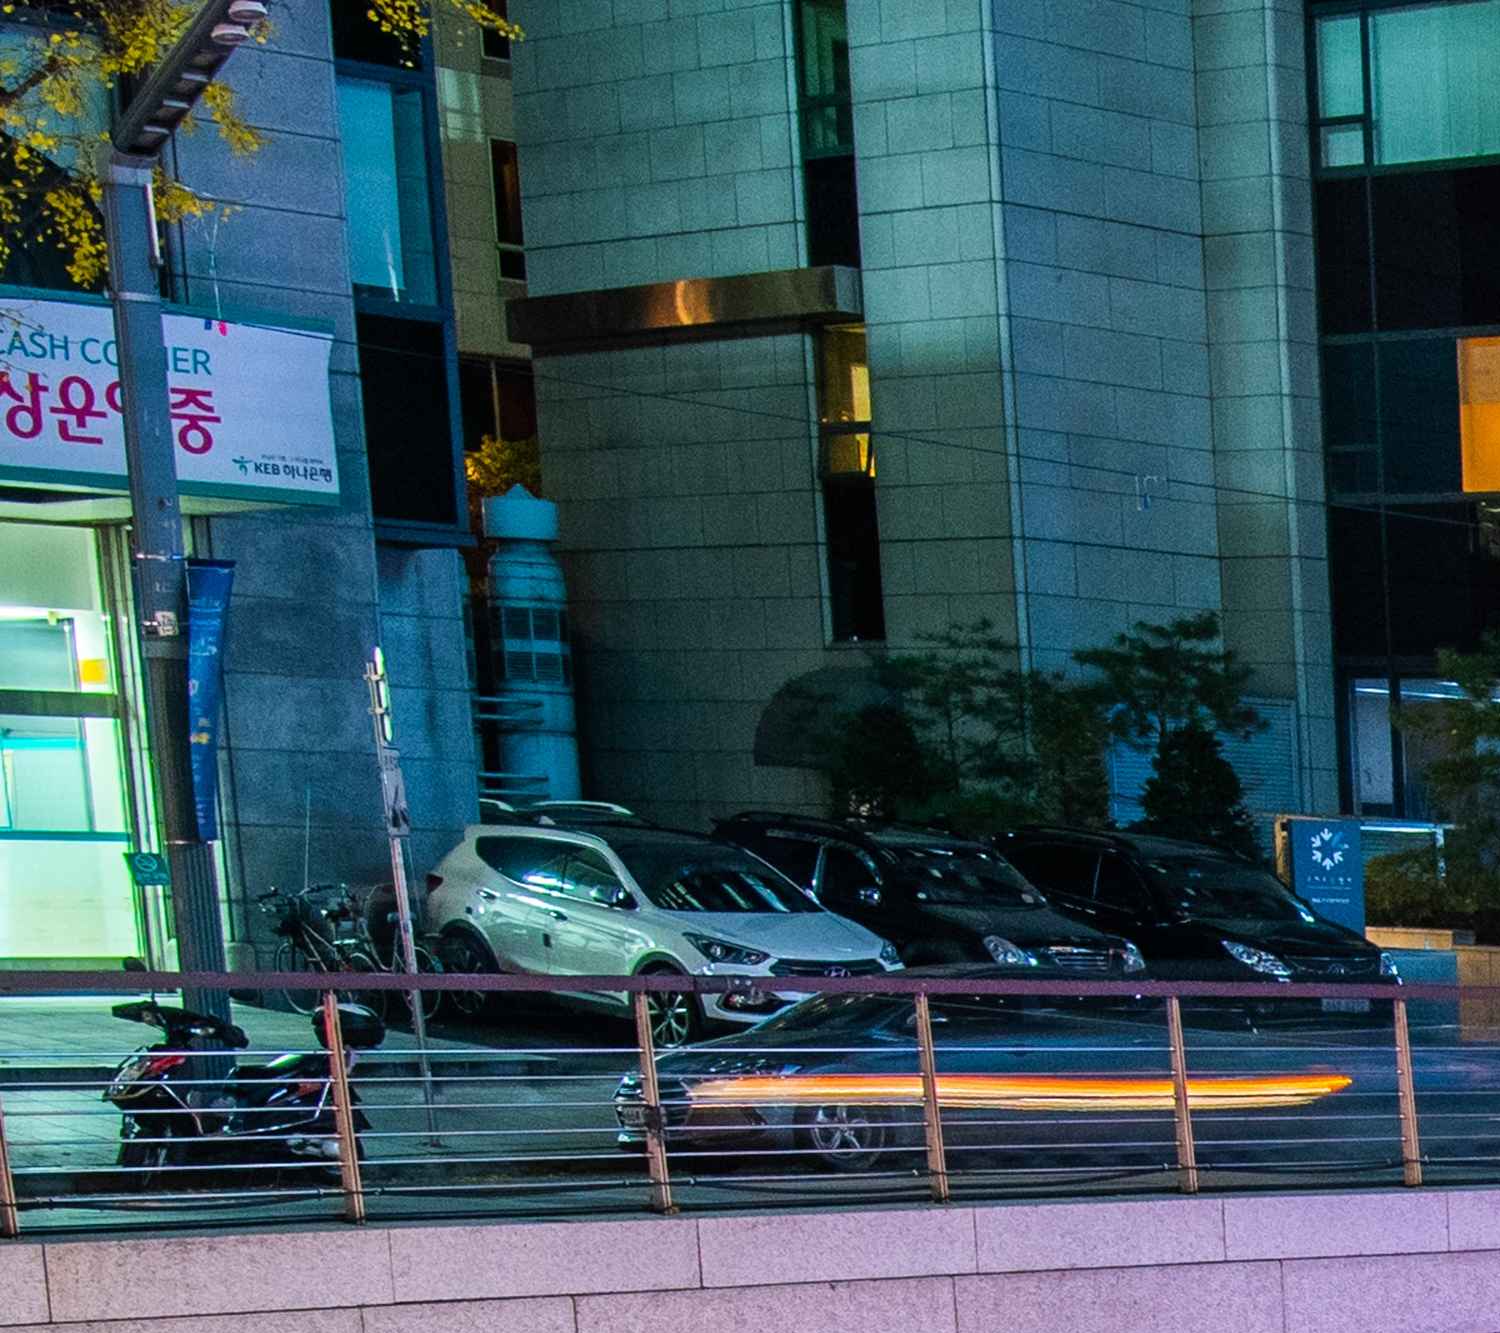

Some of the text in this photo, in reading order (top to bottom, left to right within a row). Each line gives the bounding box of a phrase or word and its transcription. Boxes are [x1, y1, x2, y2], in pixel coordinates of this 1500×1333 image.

[0, 329, 212, 376] ASH COER
[0, 370, 222, 455] 상운중
[254, 462, 280, 475] KEB
